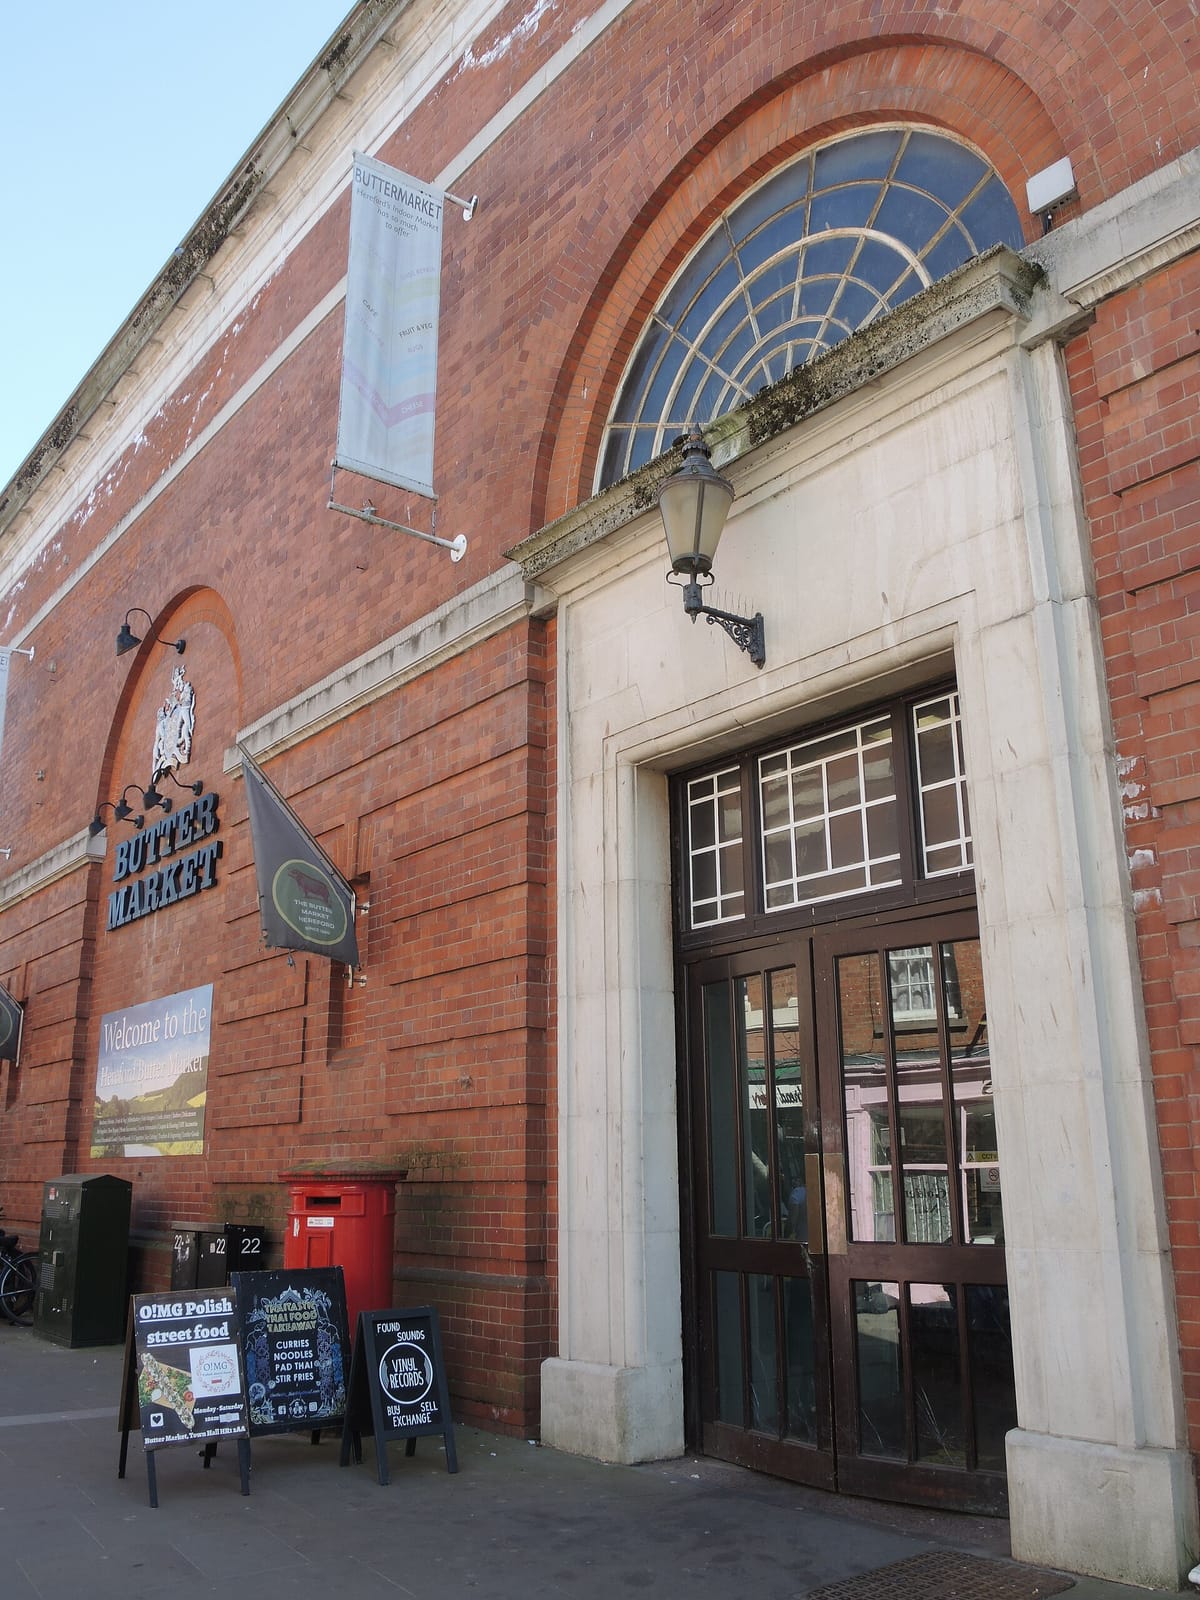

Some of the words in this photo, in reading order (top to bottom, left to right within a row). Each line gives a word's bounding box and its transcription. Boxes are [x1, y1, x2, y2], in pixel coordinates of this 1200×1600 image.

[355, 167, 442, 221] BUTTERMARKET
[393, 225, 410, 238] offer
[399, 326, 415, 339] FRUIT
[420, 322, 433, 330] VEG
[113, 792, 219, 882] BUTTER
[106, 840, 223, 931] MARKET
[298, 915, 335, 929] HEREFORD
[301, 909, 329, 920] MARKET
[103, 1016, 161, 1055] Welcome
[164, 1010, 179, 1040] to
[182, 999, 207, 1036] the
[167, 1054, 203, 1077] Market
[216, 1238, 226, 1254] 22
[240, 1237, 261, 1254] 22
[139, 1302, 184, 1320] O!MG
[185, 1297, 233, 1317] Polish
[266, 1313, 288, 1324] THAI
[290, 1310, 318, 1322] FOOD
[146, 1330, 193, 1344] street
[194, 1321, 229, 1339] food
[266, 1320, 318, 1333] TAKEAWAY
[377, 1322, 400, 1333] FOUND
[397, 1330, 425, 1342] SOUNDS
[276, 1339, 310, 1350] CURRIES
[273, 1350, 314, 1361] NOODLES
[203, 1361, 228, 1373] O!MG
[275, 1362, 292, 1373] PAD
[294, 1360, 313, 1371] THAI
[391, 1357, 418, 1373] VINYL
[275, 1374, 292, 1384] STIR
[293, 1372, 314, 1383] FRIES
[389, 1371, 424, 1389] RECORDS
[193, 1406, 217, 1415] Monday
[219, 1402, 244, 1412] Saturday
[387, 1405, 401, 1416] BUY
[420, 1401, 439, 1412] SELL
[393, 1412, 432, 1428] EXCHANGE
[144, 1436, 166, 1445] Butter
[165, 1433, 189, 1443] Market,
[189, 1431, 207, 1439] Town
[207, 1428, 220, 1438] Hall
